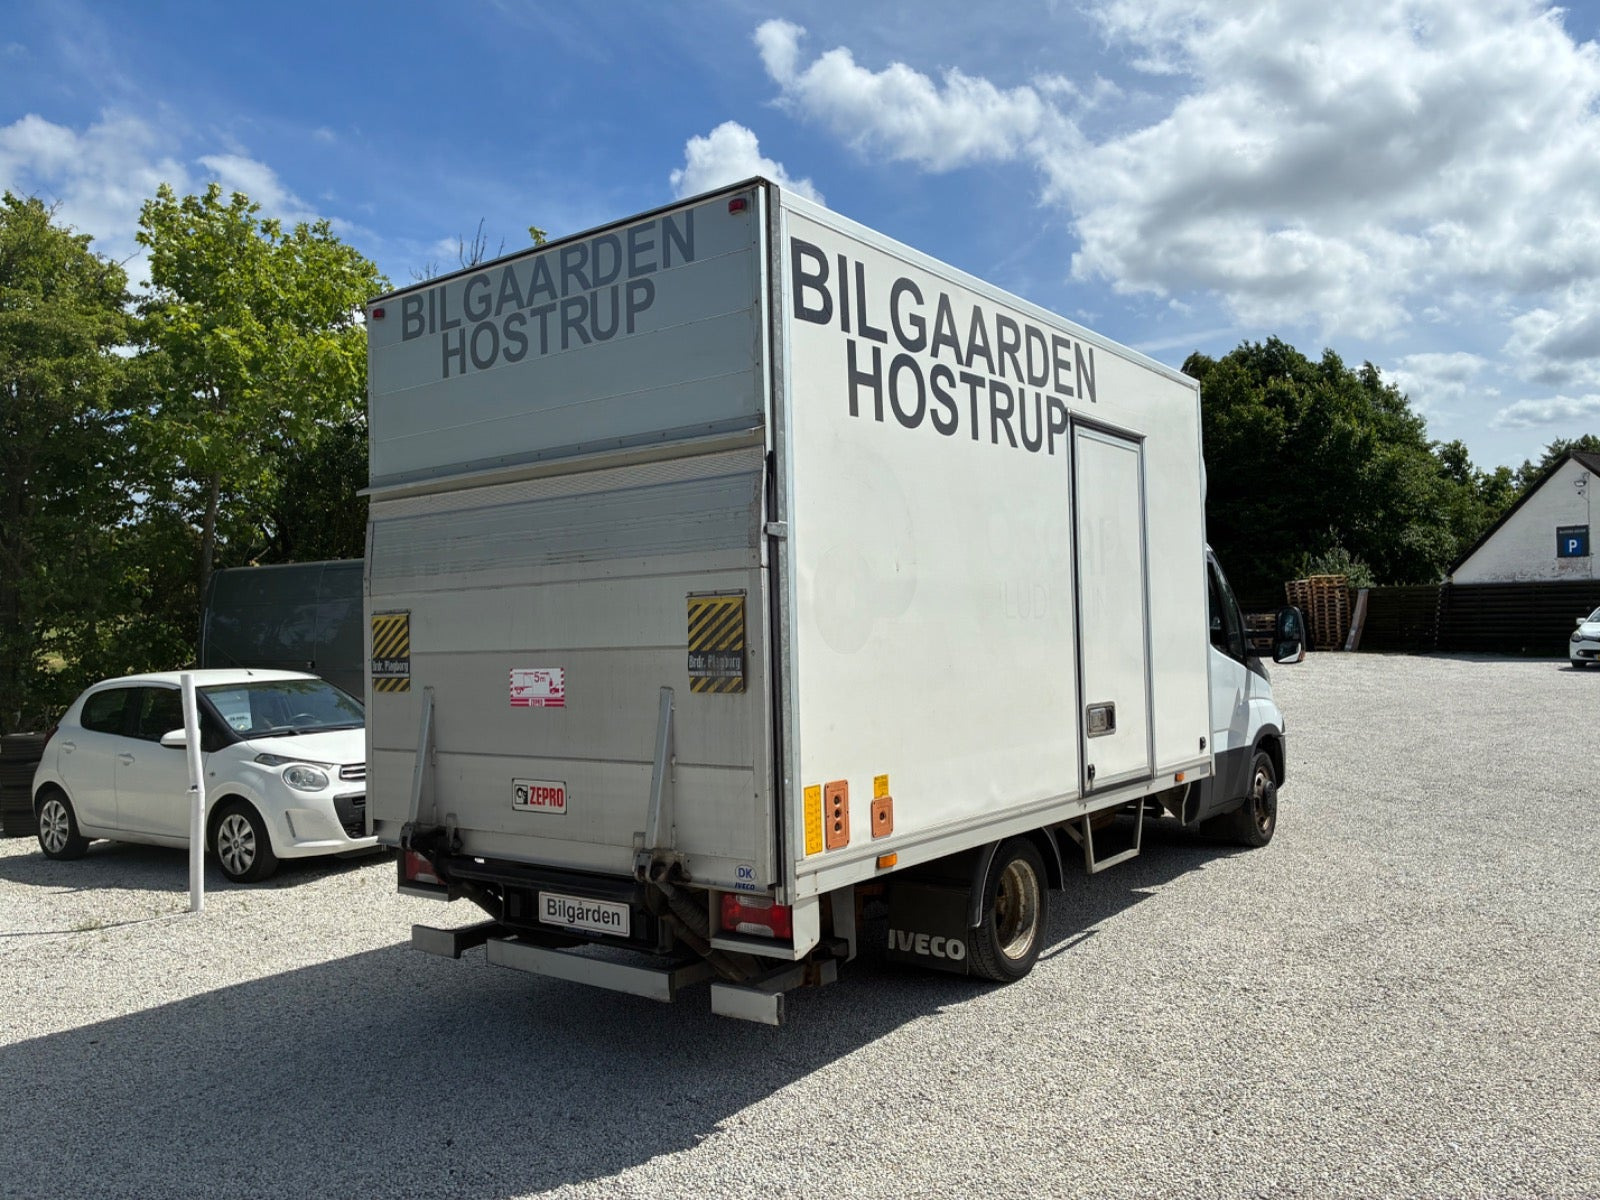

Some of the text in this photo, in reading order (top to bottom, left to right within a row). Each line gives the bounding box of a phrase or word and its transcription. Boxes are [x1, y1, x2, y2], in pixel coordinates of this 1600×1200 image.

[401, 208, 695, 342] BILGAARDEN
[442, 277, 656, 379] HOSTRUP
[790, 236, 1097, 404] BILGAARDEN
[846, 338, 1067, 456] HOSTRUP
[1568, 539, 1578, 553] P
[529, 785, 565, 808] ZEPRO
[735, 882, 755, 891] IVECO
[738, 867, 753, 879] DK
[547, 898, 620, 926] Bilgården
[888, 929, 966, 961] IVECO
